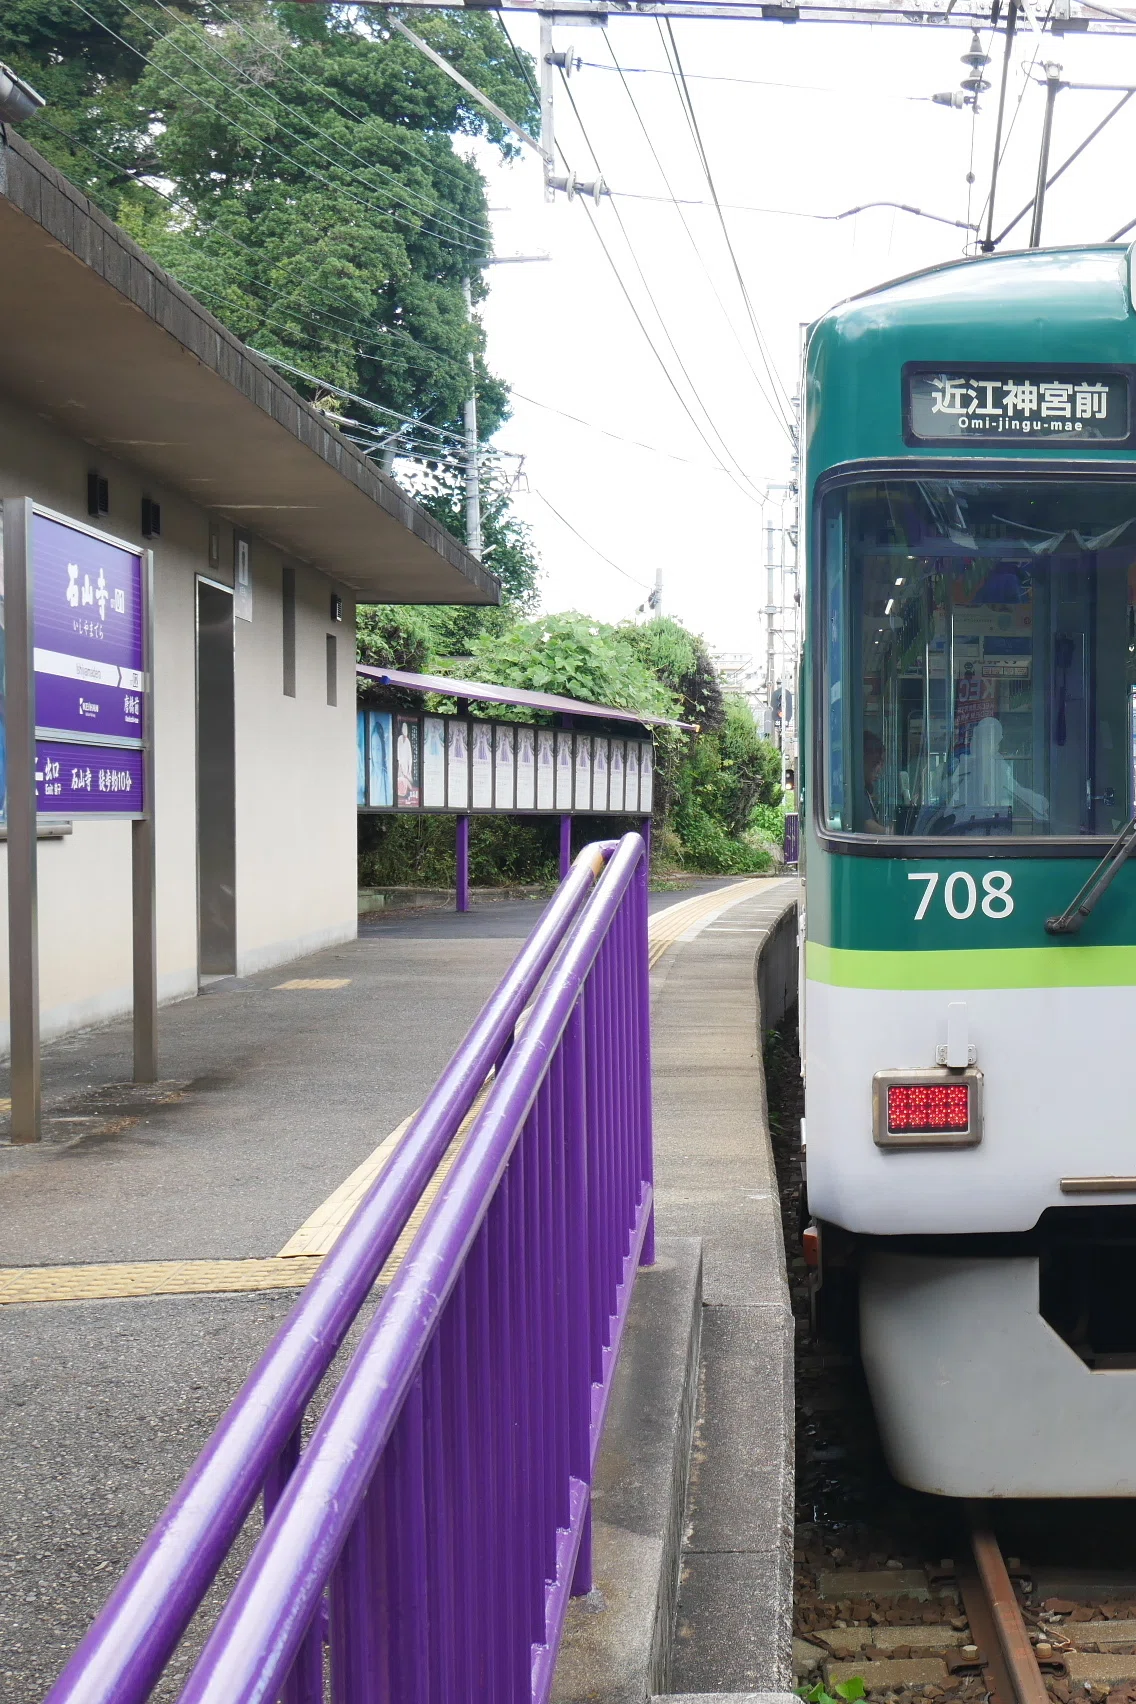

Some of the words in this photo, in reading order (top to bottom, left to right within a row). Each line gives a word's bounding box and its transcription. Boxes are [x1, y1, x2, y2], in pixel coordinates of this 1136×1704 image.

[931, 377, 1109, 419] 近江神宮前
[957, 416, 1084, 433] Omi-jingu-mae
[66, 563, 108, 621] 石山寺
[71, 767, 92, 792] 石山寺
[907, 870, 1015, 921] 708
